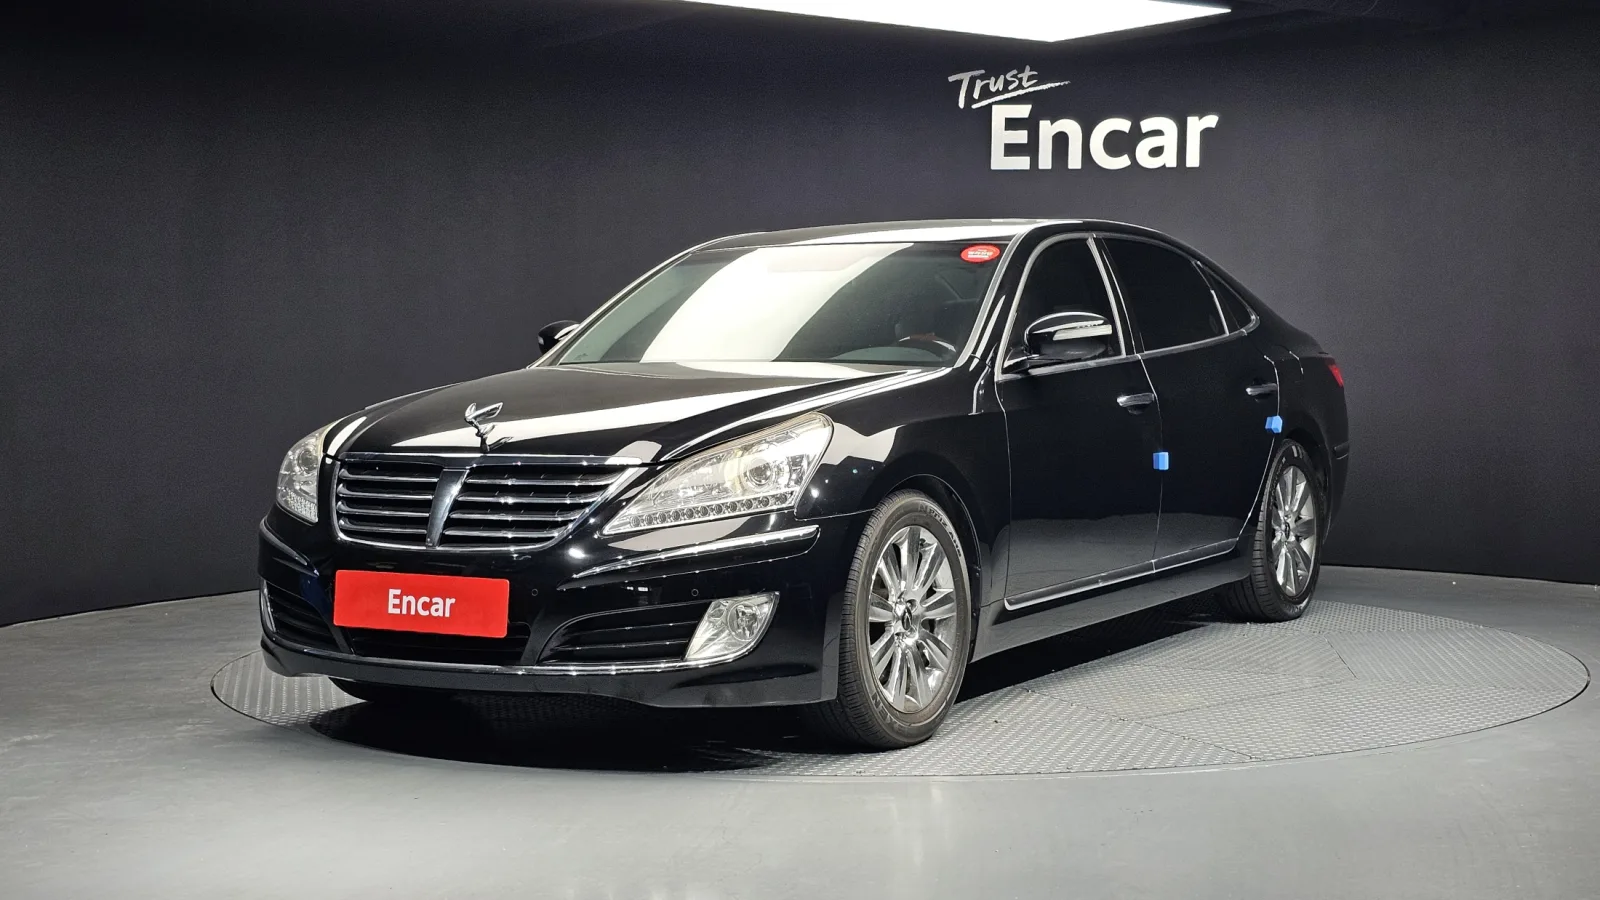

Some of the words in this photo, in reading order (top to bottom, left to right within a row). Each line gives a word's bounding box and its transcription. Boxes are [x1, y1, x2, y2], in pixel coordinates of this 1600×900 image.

[948, 65, 1039, 109] Trust
[990, 104, 1219, 170] Encar
[387, 588, 456, 618] Encar
